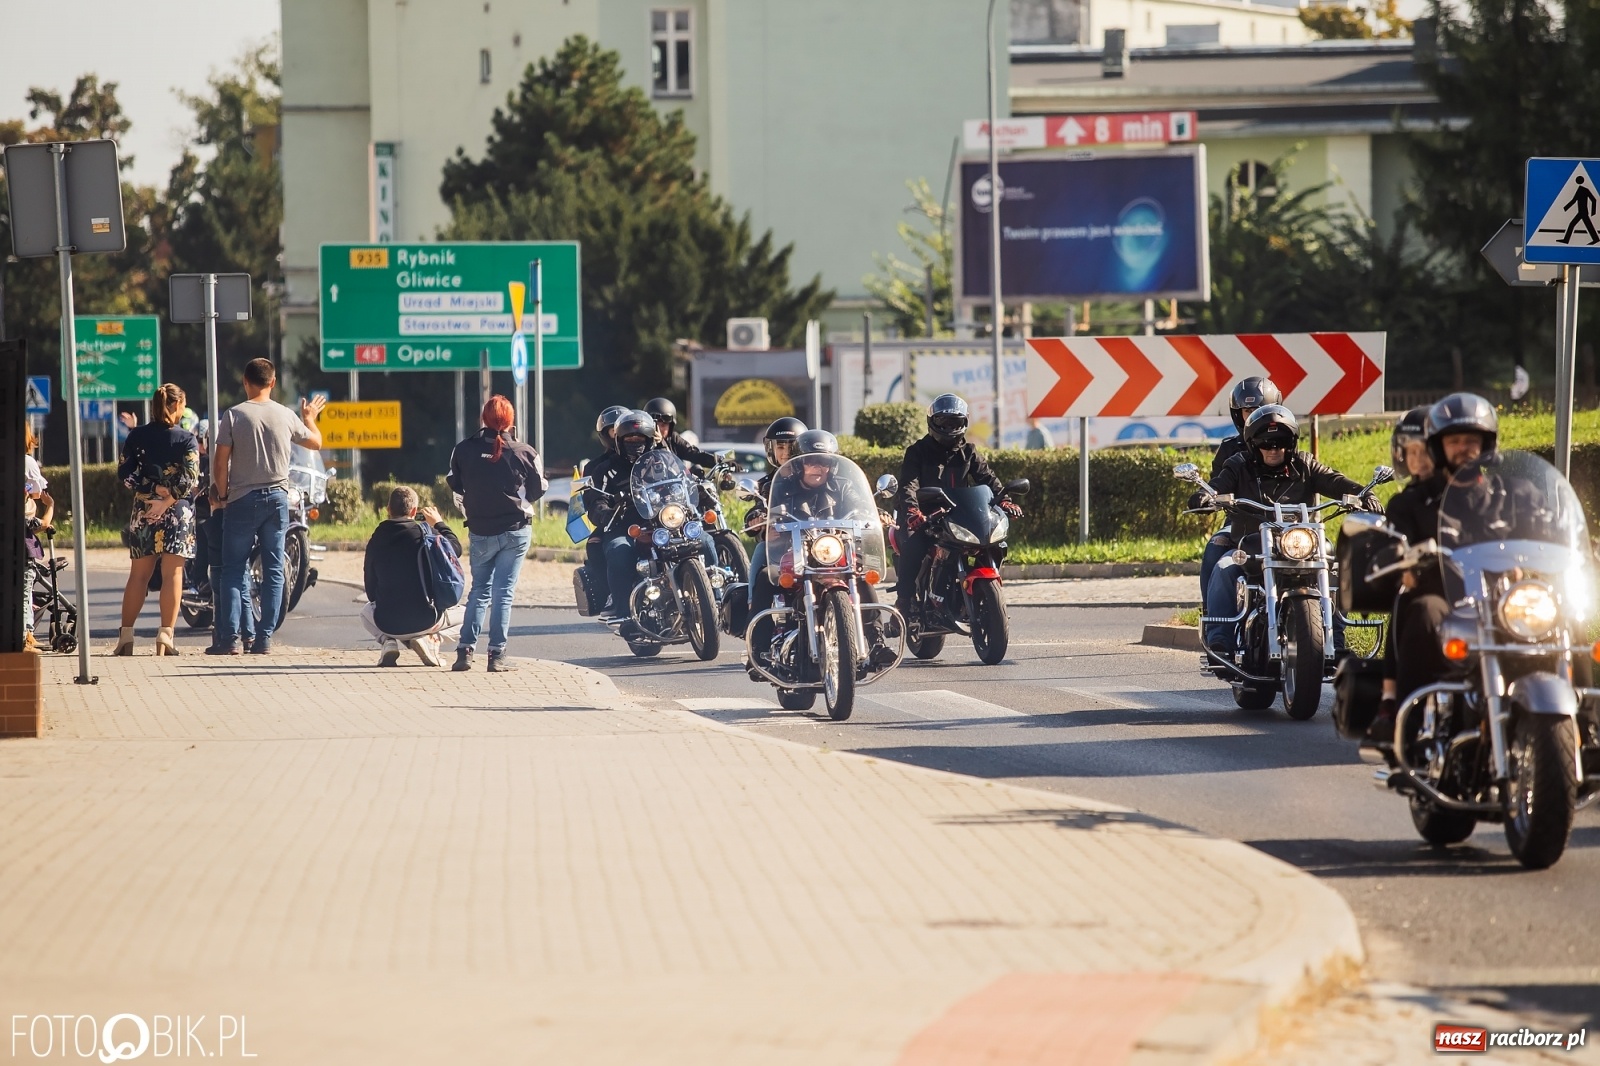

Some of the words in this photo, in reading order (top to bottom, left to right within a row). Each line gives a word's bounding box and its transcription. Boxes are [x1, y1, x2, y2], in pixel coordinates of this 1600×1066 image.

[1095, 116, 1109, 143] 8
[1122, 115, 1163, 140] min
[357, 252, 382, 265] 935
[397, 249, 456, 269] Rybnik
[396, 271, 462, 288] Gliwice
[449, 296, 497, 312] Miejski
[404, 317, 471, 331] Starostwo
[362, 345, 380, 361] 45
[397, 344, 452, 365] Opole
[326, 407, 372, 421] Objazd
[326, 431, 343, 443] do
[347, 430, 398, 444] Rybnika
